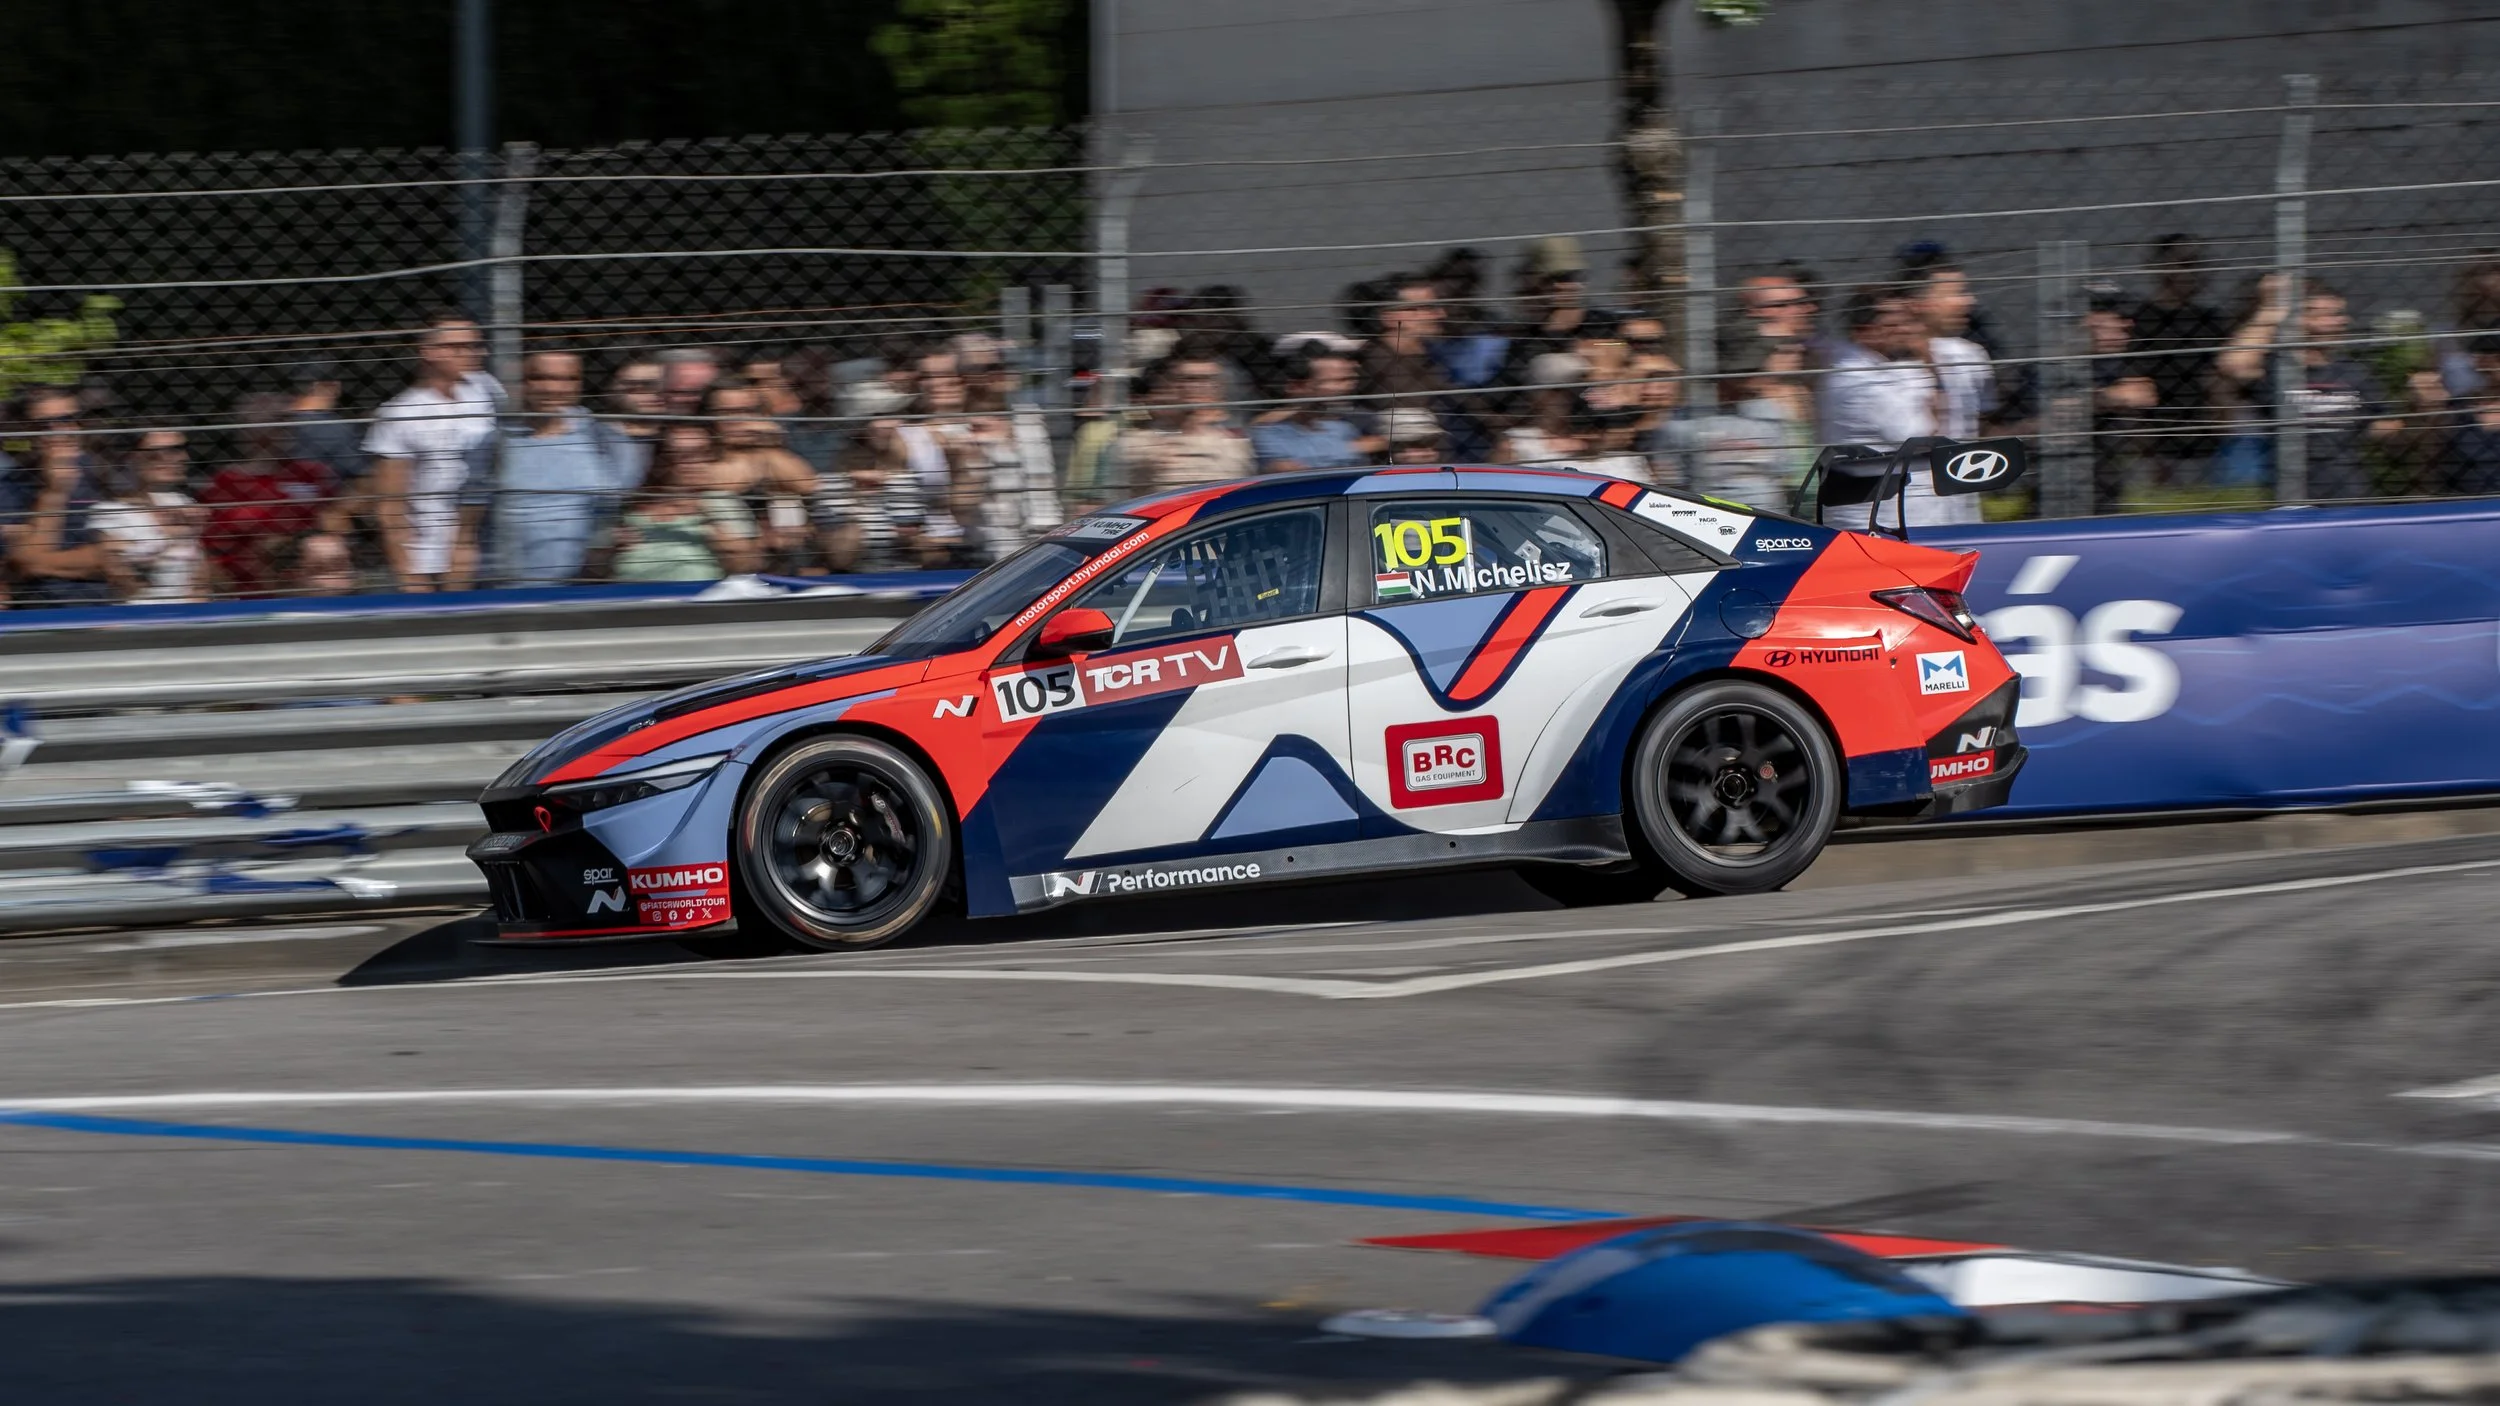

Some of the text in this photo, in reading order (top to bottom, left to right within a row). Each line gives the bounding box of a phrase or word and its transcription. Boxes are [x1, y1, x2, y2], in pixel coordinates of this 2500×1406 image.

[1091, 521, 1132, 530] KUMHO
[1374, 517, 1467, 569] 105
[1756, 538, 1811, 552] sparco
[1015, 531, 1149, 627] motorsport.hyundai.com
[1415, 560, 1573, 592] N.Michelisz
[1086, 646, 1229, 693] TCR TV
[1800, 648, 1879, 664] HYUNDAI
[997, 670, 1075, 716] 105
[1925, 681, 1965, 691] MARELLI
[1413, 745, 1476, 773] BRC
[1415, 770, 1476, 783] GAS EQUIPMENT
[631, 867, 724, 889] KUMHO
[1107, 863, 1261, 893] Performance
